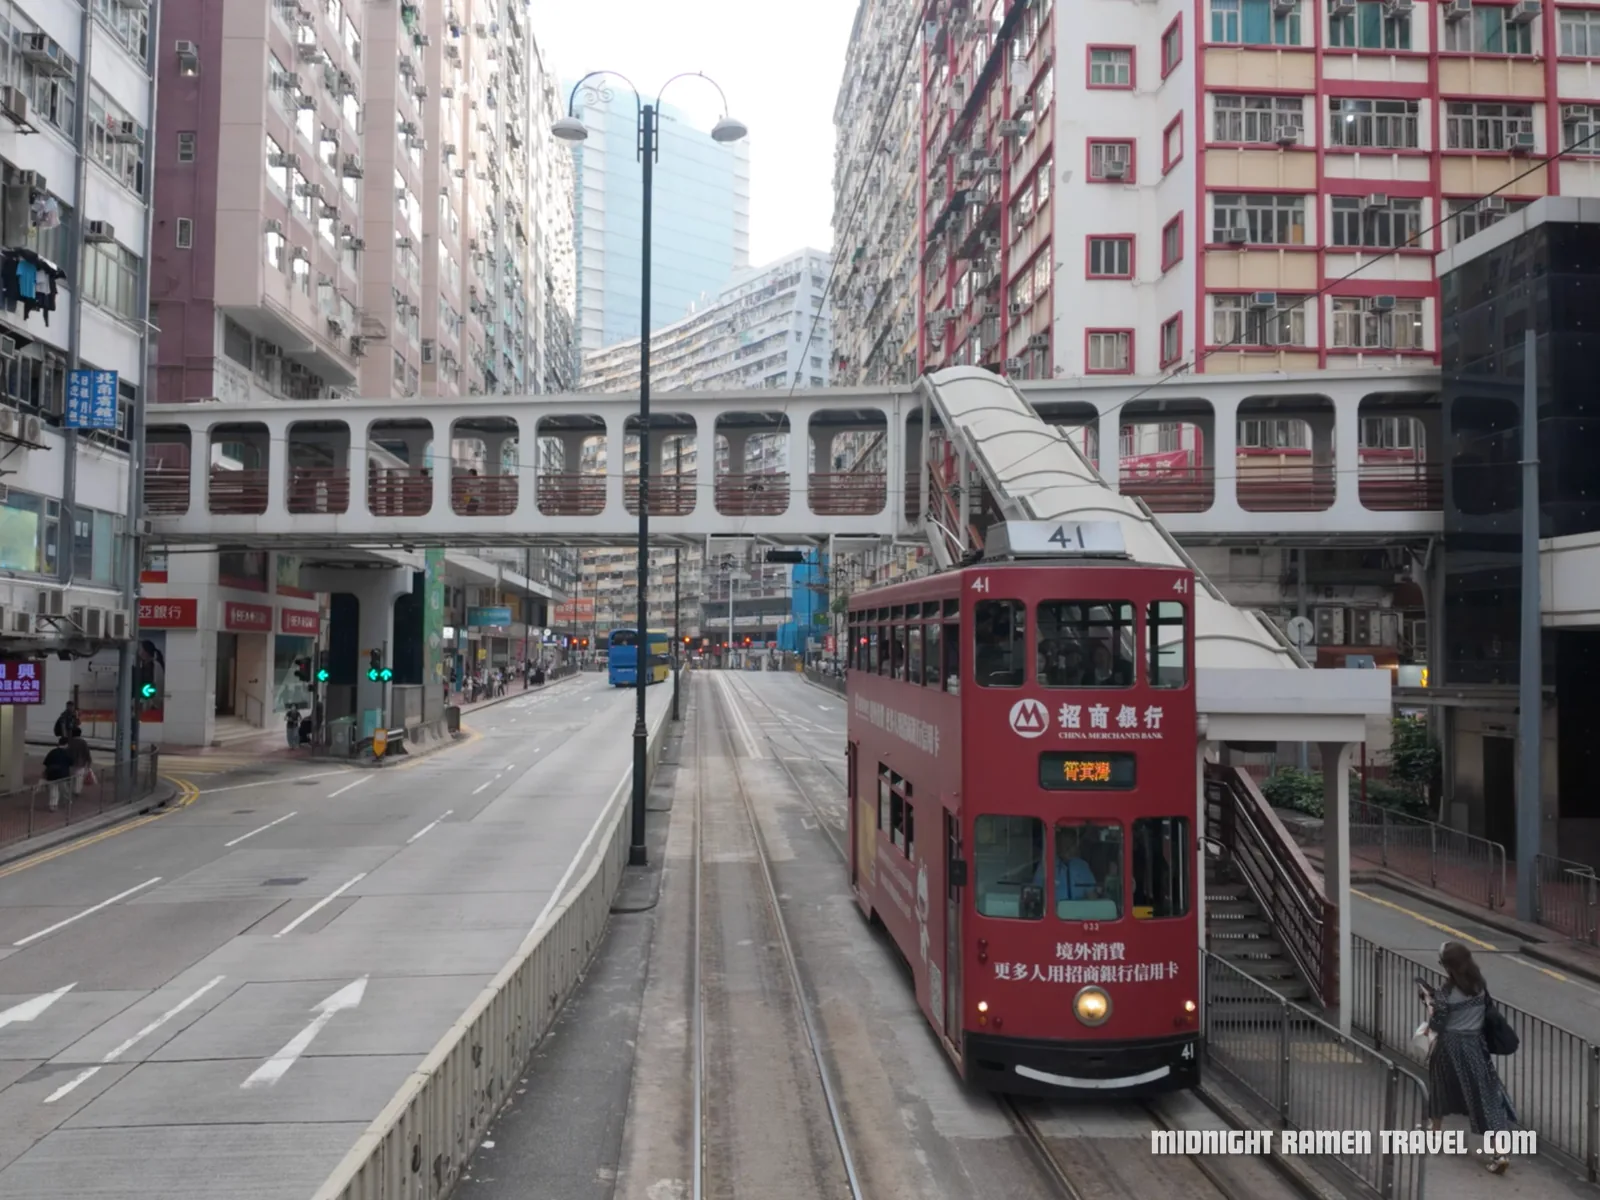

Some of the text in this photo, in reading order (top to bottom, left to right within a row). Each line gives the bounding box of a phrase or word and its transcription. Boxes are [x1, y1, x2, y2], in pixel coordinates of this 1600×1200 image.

[1048, 525, 1085, 549] 41
[971, 577, 989, 593] 41
[1172, 578, 1188, 594] 41
[1057, 703, 1164, 729] 招商銀行
[1058, 731, 1087, 739] CHINA
[1088, 731, 1140, 740] MERCHANTS
[1056, 942, 1126, 961] 境外消費
[993, 961, 1179, 984] 更多人用招商銀行信用卡
[1181, 1043, 1194, 1060] 41
